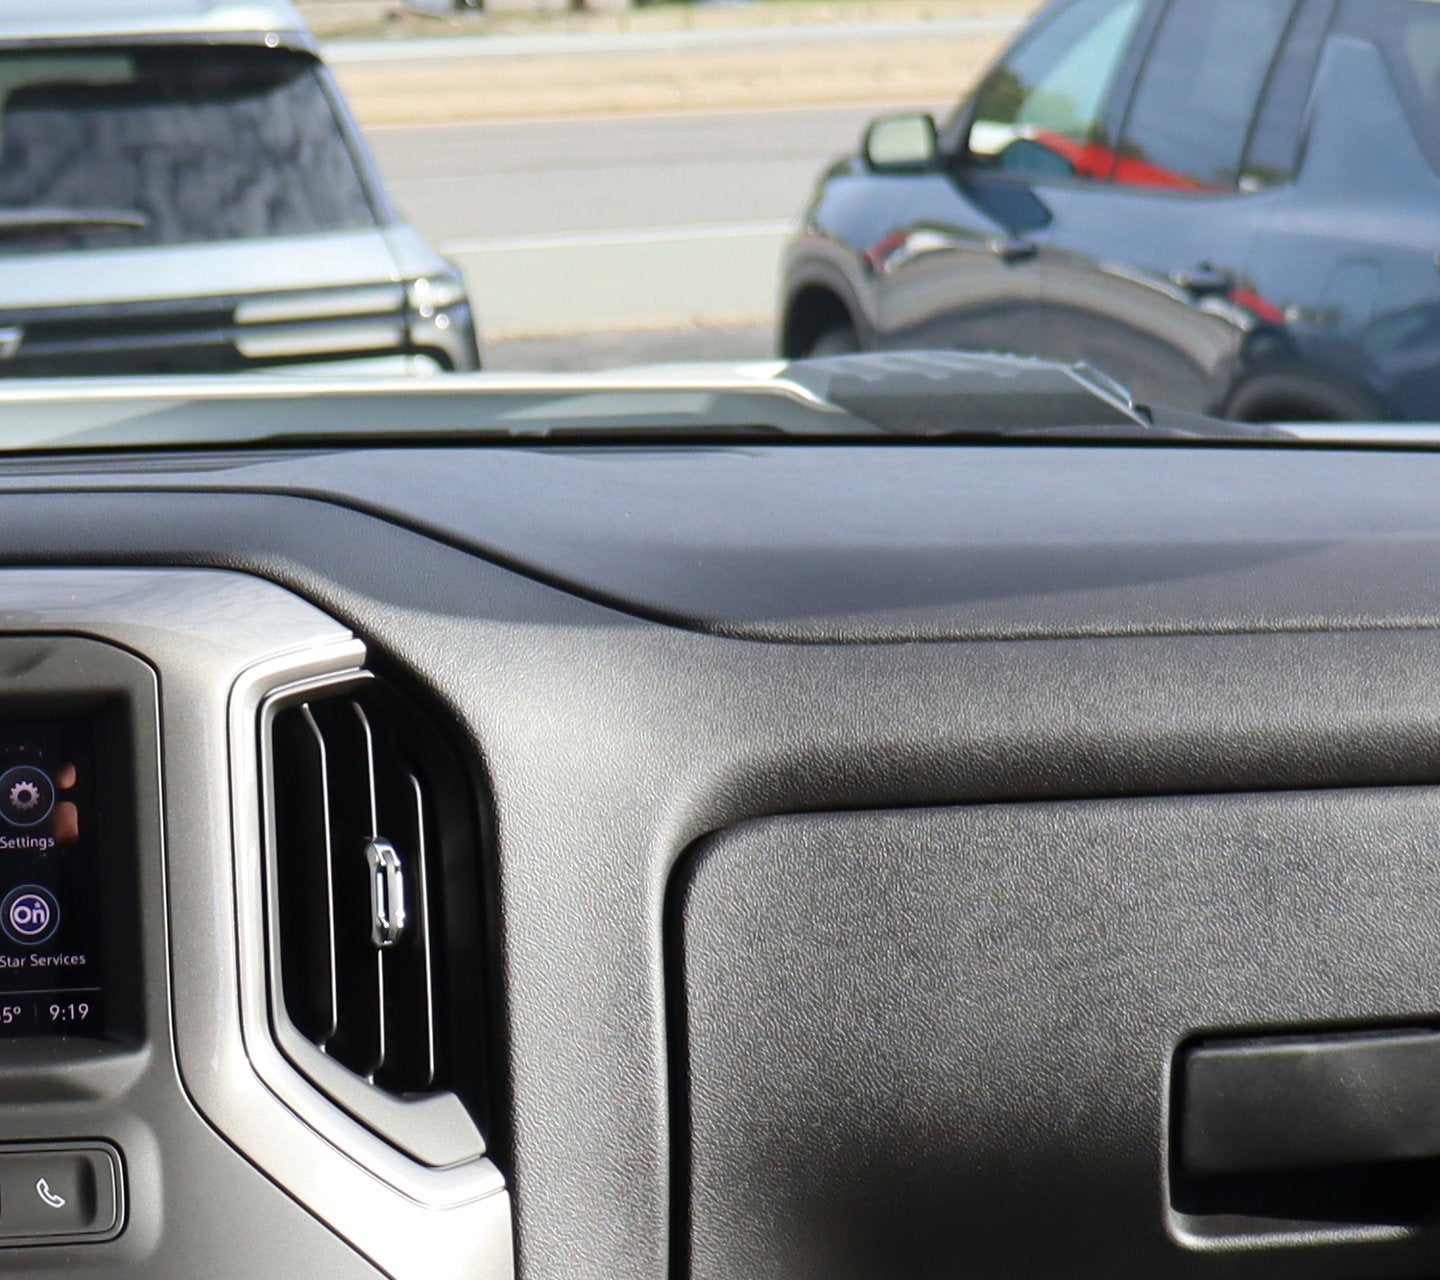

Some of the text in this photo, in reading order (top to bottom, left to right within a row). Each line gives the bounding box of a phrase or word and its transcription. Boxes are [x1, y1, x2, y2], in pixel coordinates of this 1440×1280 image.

[0, 835, 56, 852] Settings
[29, 952, 88, 967] Services
[48, 1003, 91, 1022] 9:19
